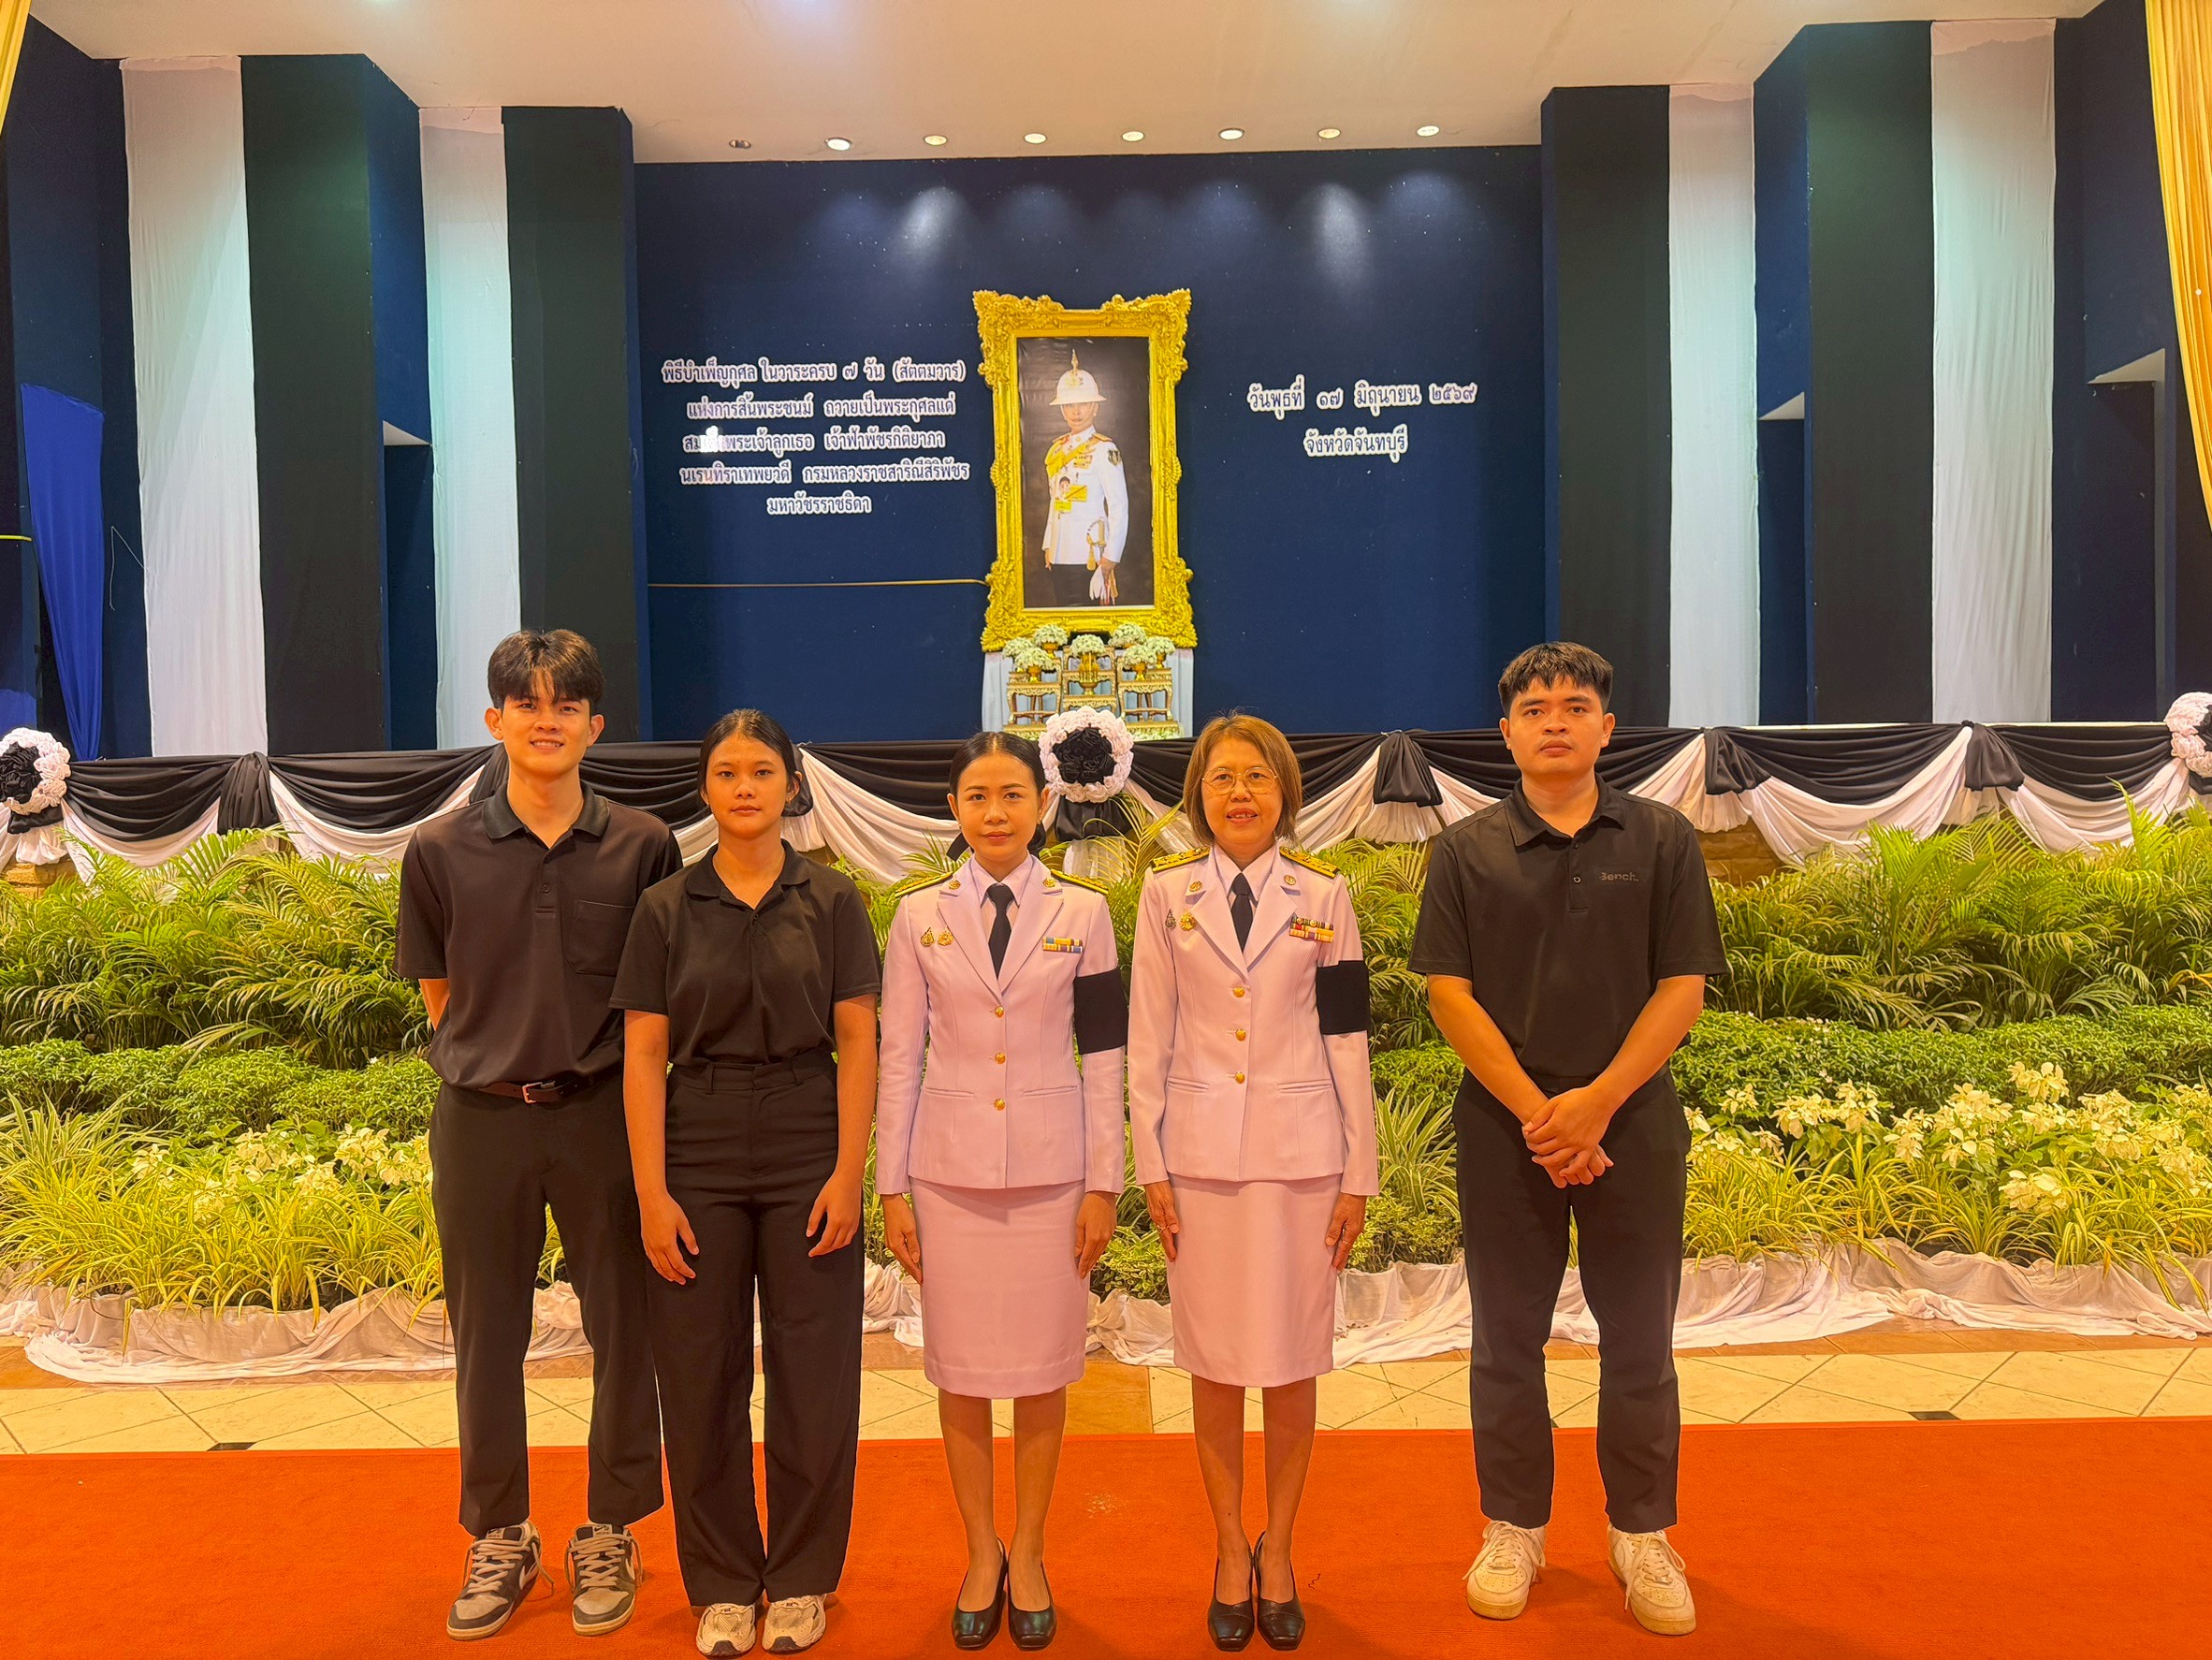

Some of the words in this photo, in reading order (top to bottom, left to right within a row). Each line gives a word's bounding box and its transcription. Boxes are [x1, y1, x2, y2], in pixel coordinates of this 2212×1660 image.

[662, 357, 757, 389] พิธีบำเพ็ญกุศล
[759, 357, 837, 383] ในวาระครบ
[842, 362, 858, 380] ๗
[864, 357, 885, 382] วัน
[893, 357, 966, 383] (สัตตมวาร)
[687, 391, 813, 419] แห่งการสิ้นพระชนม์
[823, 390, 955, 423] ถวายเป็นพระกุศลแด่
[1247, 374, 1304, 420] วันพุธที่
[1317, 387, 1344, 409] ๑๗
[1354, 379, 1422, 416] มิถุนายน
[1429, 383, 1477, 404] ๒๕๖๙
[682, 426, 815, 458] สมพระเจ้าลูกเธอ
[824, 425, 945, 451] เจ้าฟ้าพัชรกิติยาภา
[1303, 424, 1408, 463] จังหวัดจันทบุรี
[679, 459, 792, 485] นเรนทิราเทพยวดี
[802, 457, 969, 483] กรมหลวงราชสาริณีสิริพัชร
[766, 490, 871, 515] มหาวัชรราชธิดา
